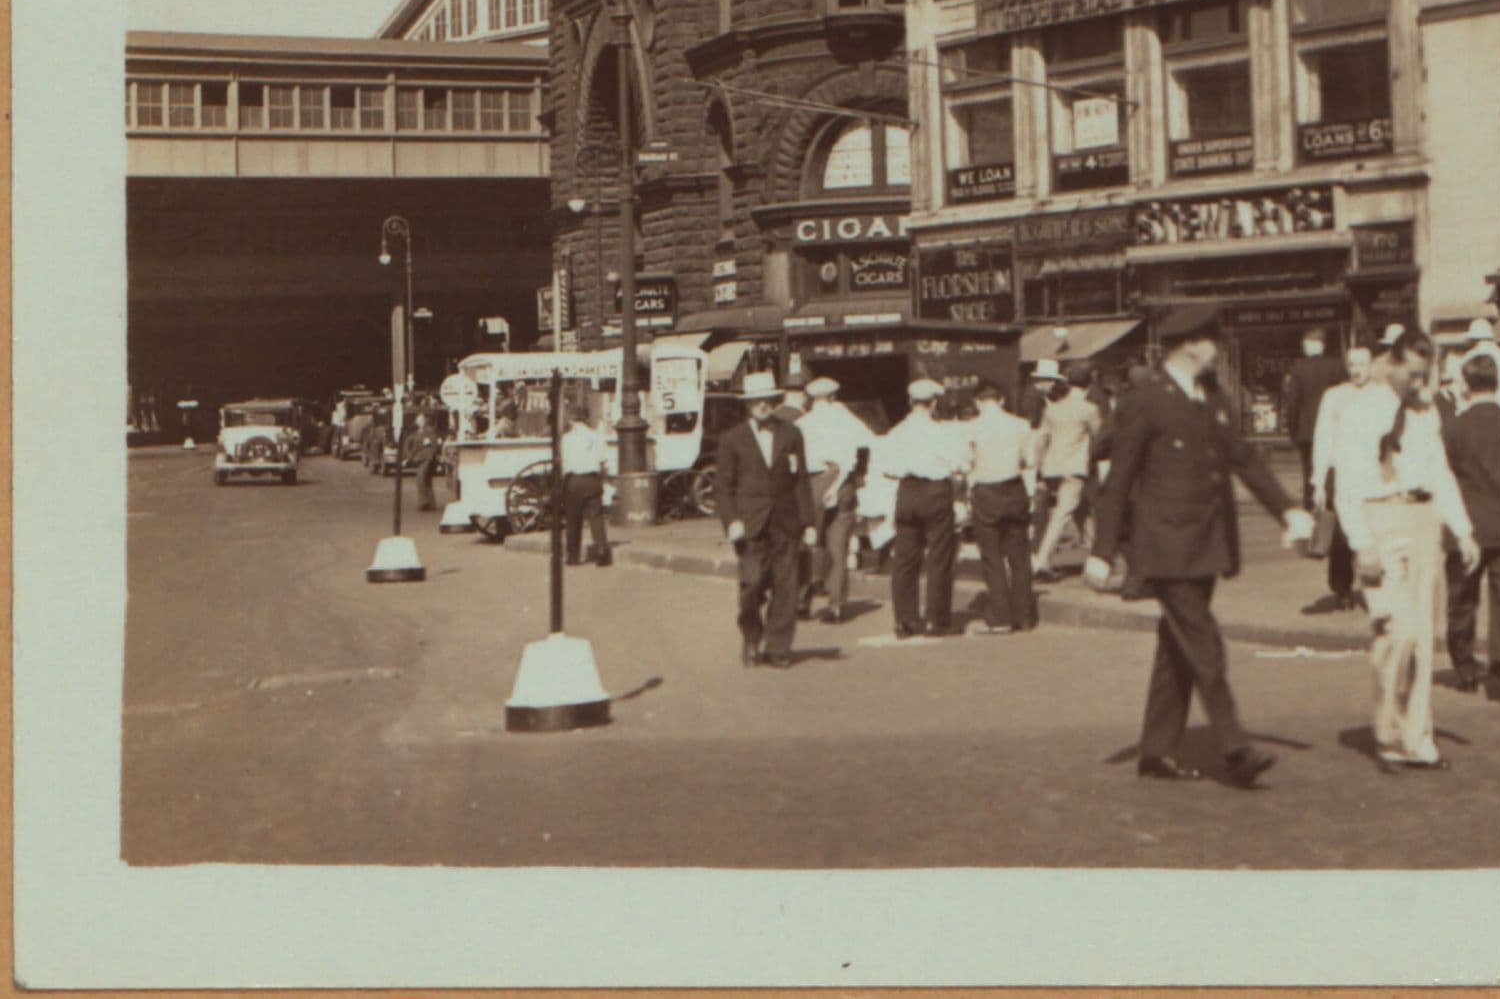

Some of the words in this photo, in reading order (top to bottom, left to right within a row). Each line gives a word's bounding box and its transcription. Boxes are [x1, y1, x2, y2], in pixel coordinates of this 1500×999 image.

[1304, 125, 1354, 149] LOANS
[958, 167, 975, 186] WE
[978, 162, 1012, 182] LOAN
[661, 392, 677, 411] 5
